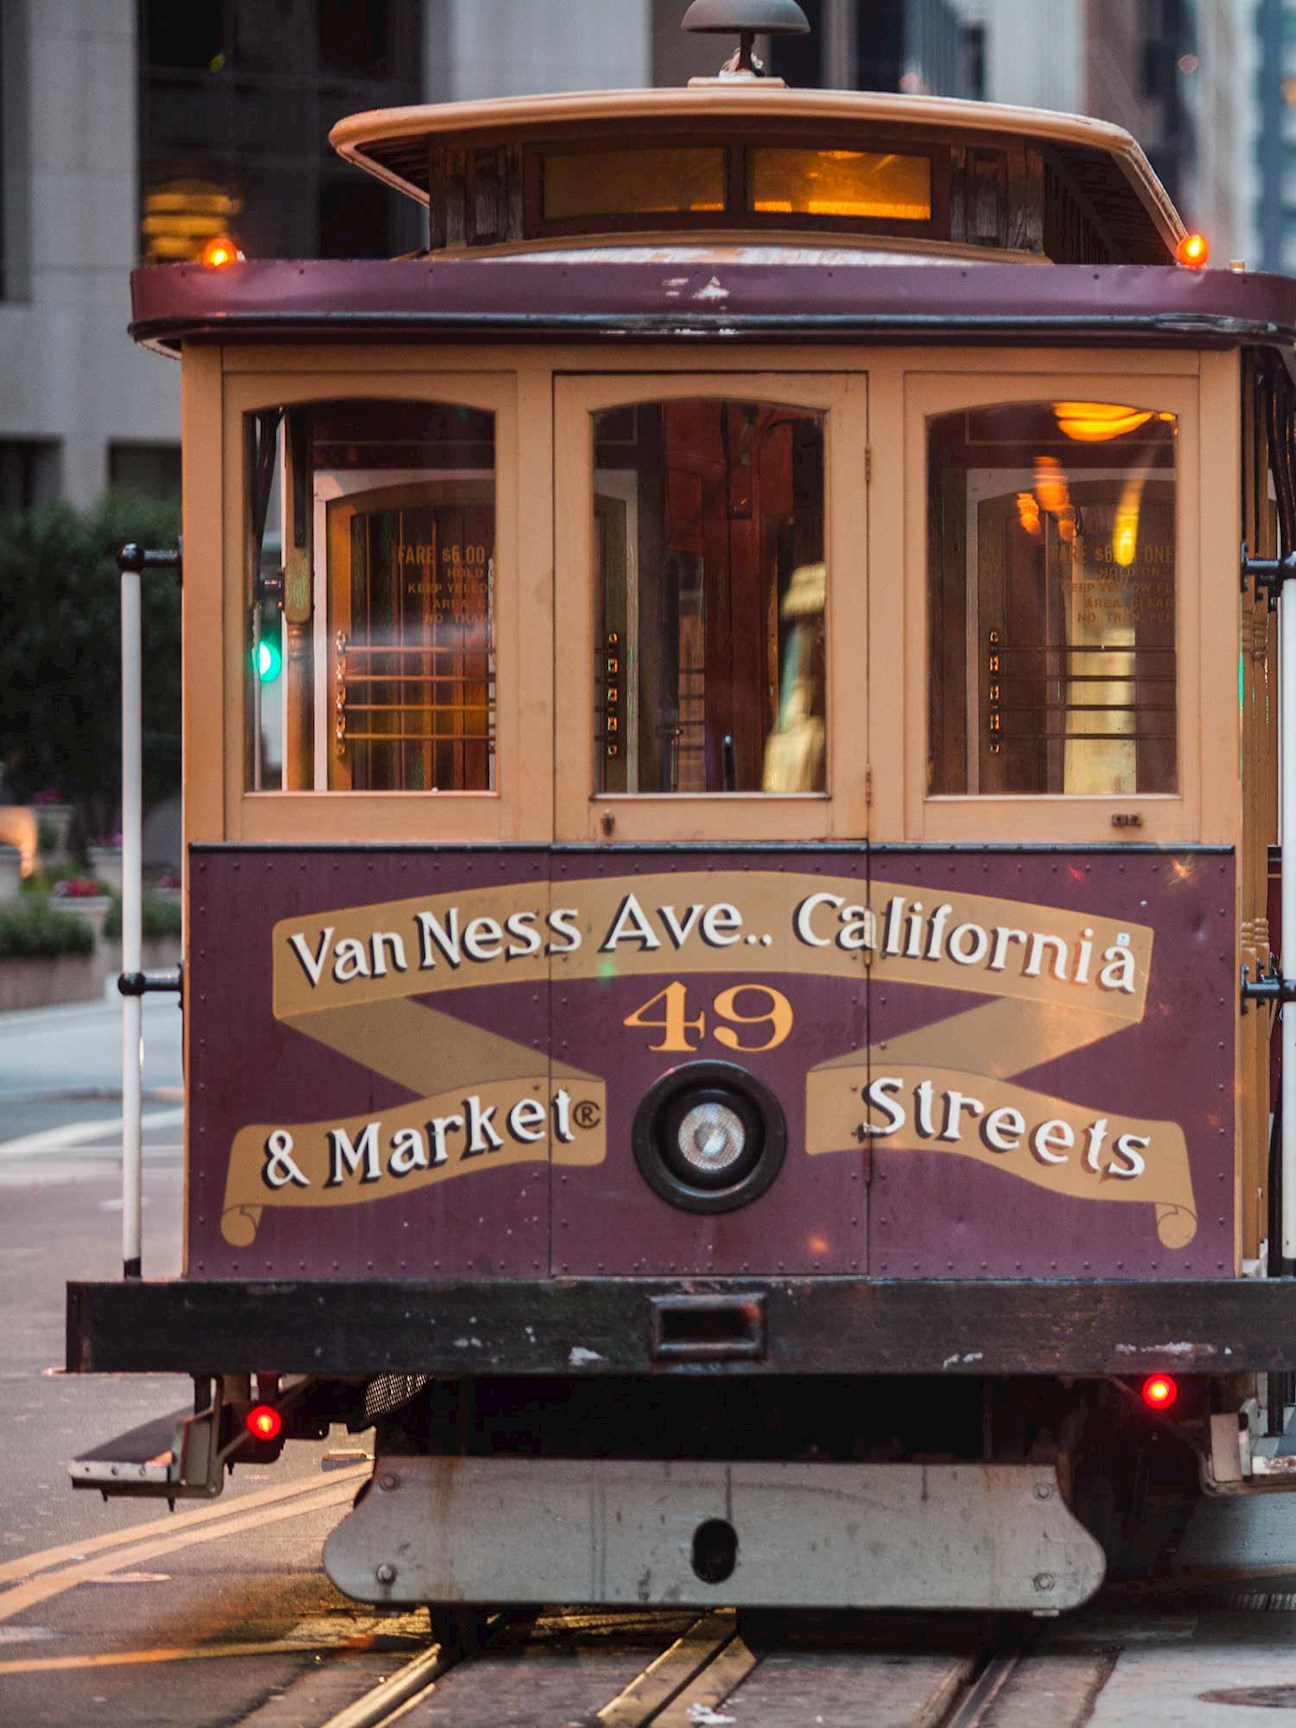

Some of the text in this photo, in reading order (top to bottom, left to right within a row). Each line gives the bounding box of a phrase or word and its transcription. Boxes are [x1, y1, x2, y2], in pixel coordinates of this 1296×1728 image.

[397, 545, 435, 564] FARE
[289, 926, 406, 987] Van
[413, 907, 582, 970] Ness
[793, 891, 1137, 994] California
[623, 980, 794, 1052] 49
[262, 1128, 310, 1189] &
[858, 1076, 1152, 1179] Streets
